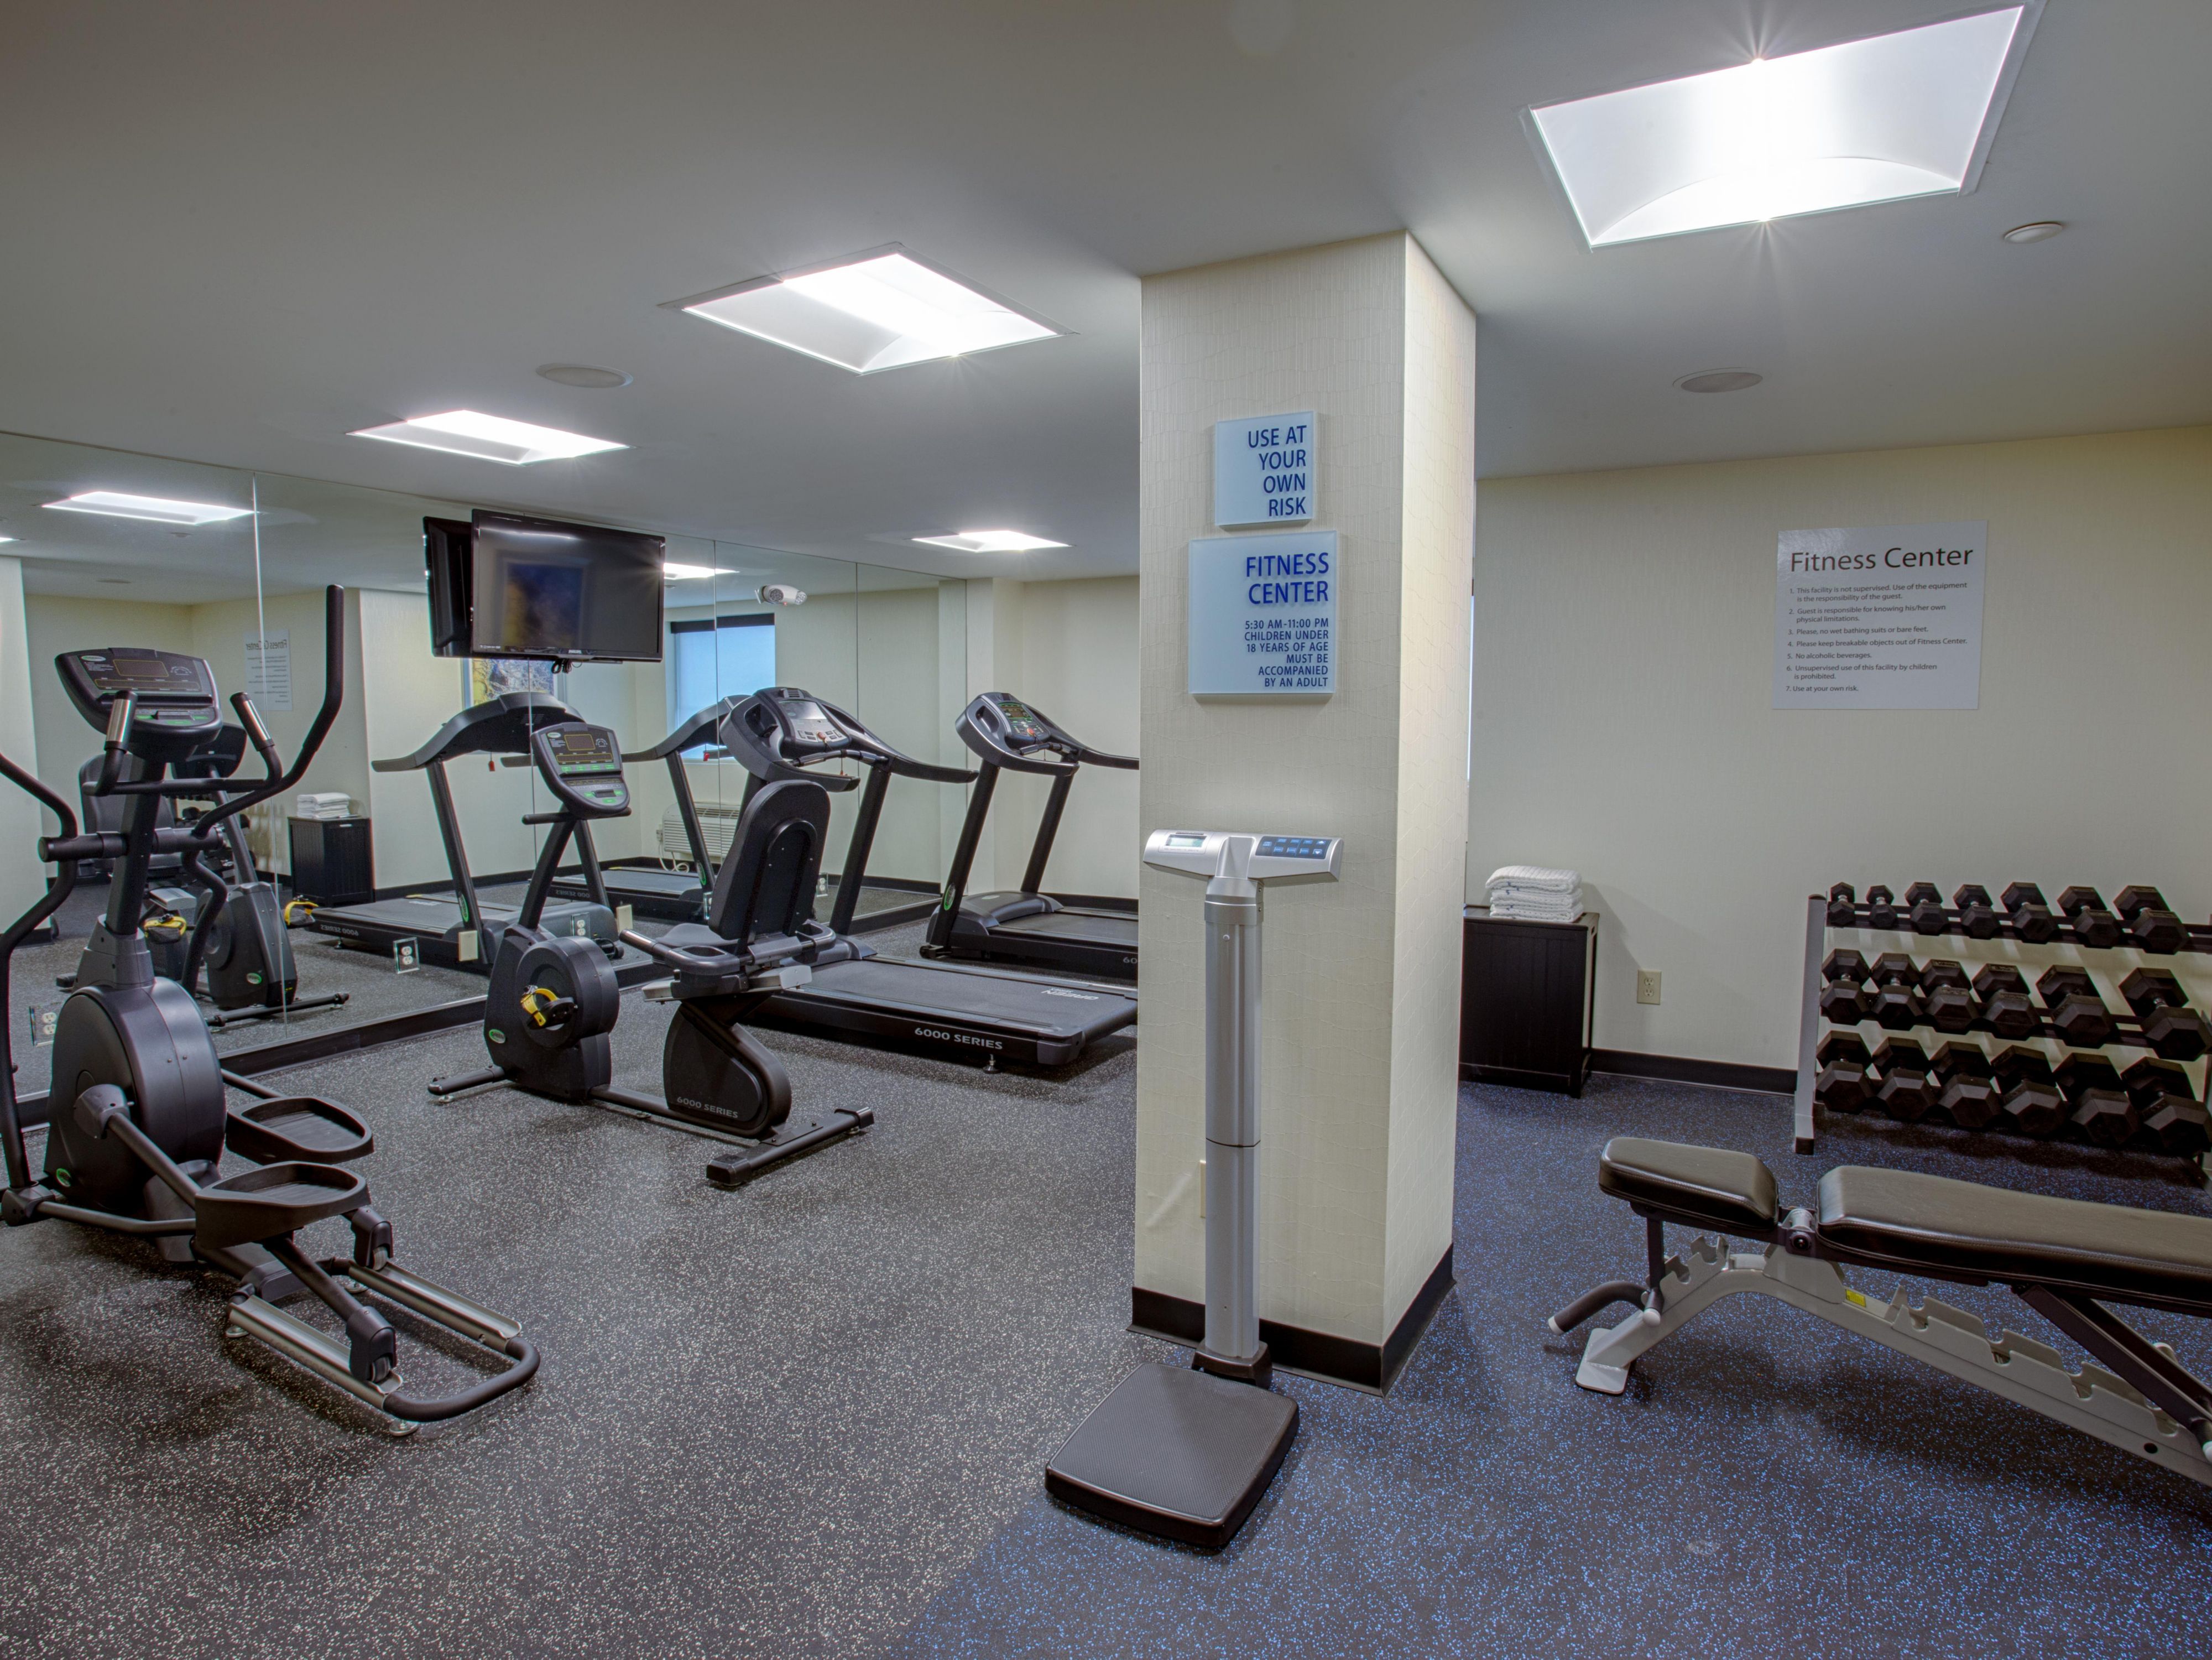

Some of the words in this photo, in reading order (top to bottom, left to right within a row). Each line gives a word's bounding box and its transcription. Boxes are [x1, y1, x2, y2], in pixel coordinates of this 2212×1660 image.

[1248, 428, 1280, 448] USE
[1286, 425, 1307, 444] AT
[1259, 449, 1306, 470] YOUR
[1263, 472, 1306, 493] OWN
[1269, 496, 1306, 517] RISK
[1246, 552, 1329, 577] FITNESS
[1791, 551, 1876, 572] Fitness
[1884, 547, 1973, 568] Center
[1248, 580, 1329, 605] CENTER
[1815, 594, 1859, 602] responsibility
[1853, 584, 1891, 592] supervised.
[1245, 620, 1264, 629] 5:30
[1314, 618, 1328, 627] PM
[1244, 631, 1291, 641] CHILDREN
[1295, 629, 1328, 639] UNDER
[1246, 643, 1256, 652] 18
[1260, 642, 1290, 652] YEARS
[1293, 642, 1306, 651] OF
[1310, 642, 1328, 651] AGE
[1286, 654, 1313, 663] MUST
[1317, 653, 1328, 663] BE
[1258, 665, 1328, 675] ACCOMPANIED
[1265, 678, 1276, 687] BY
[1279, 677, 1293, 686] AN
[1296, 677, 1328, 687] ADULT
[915, 1027, 950, 1040] 6000
[953, 1034, 1003, 1050] SERIES
[676, 1096, 702, 1109] 6000
[703, 1104, 739, 1118] SERIES
